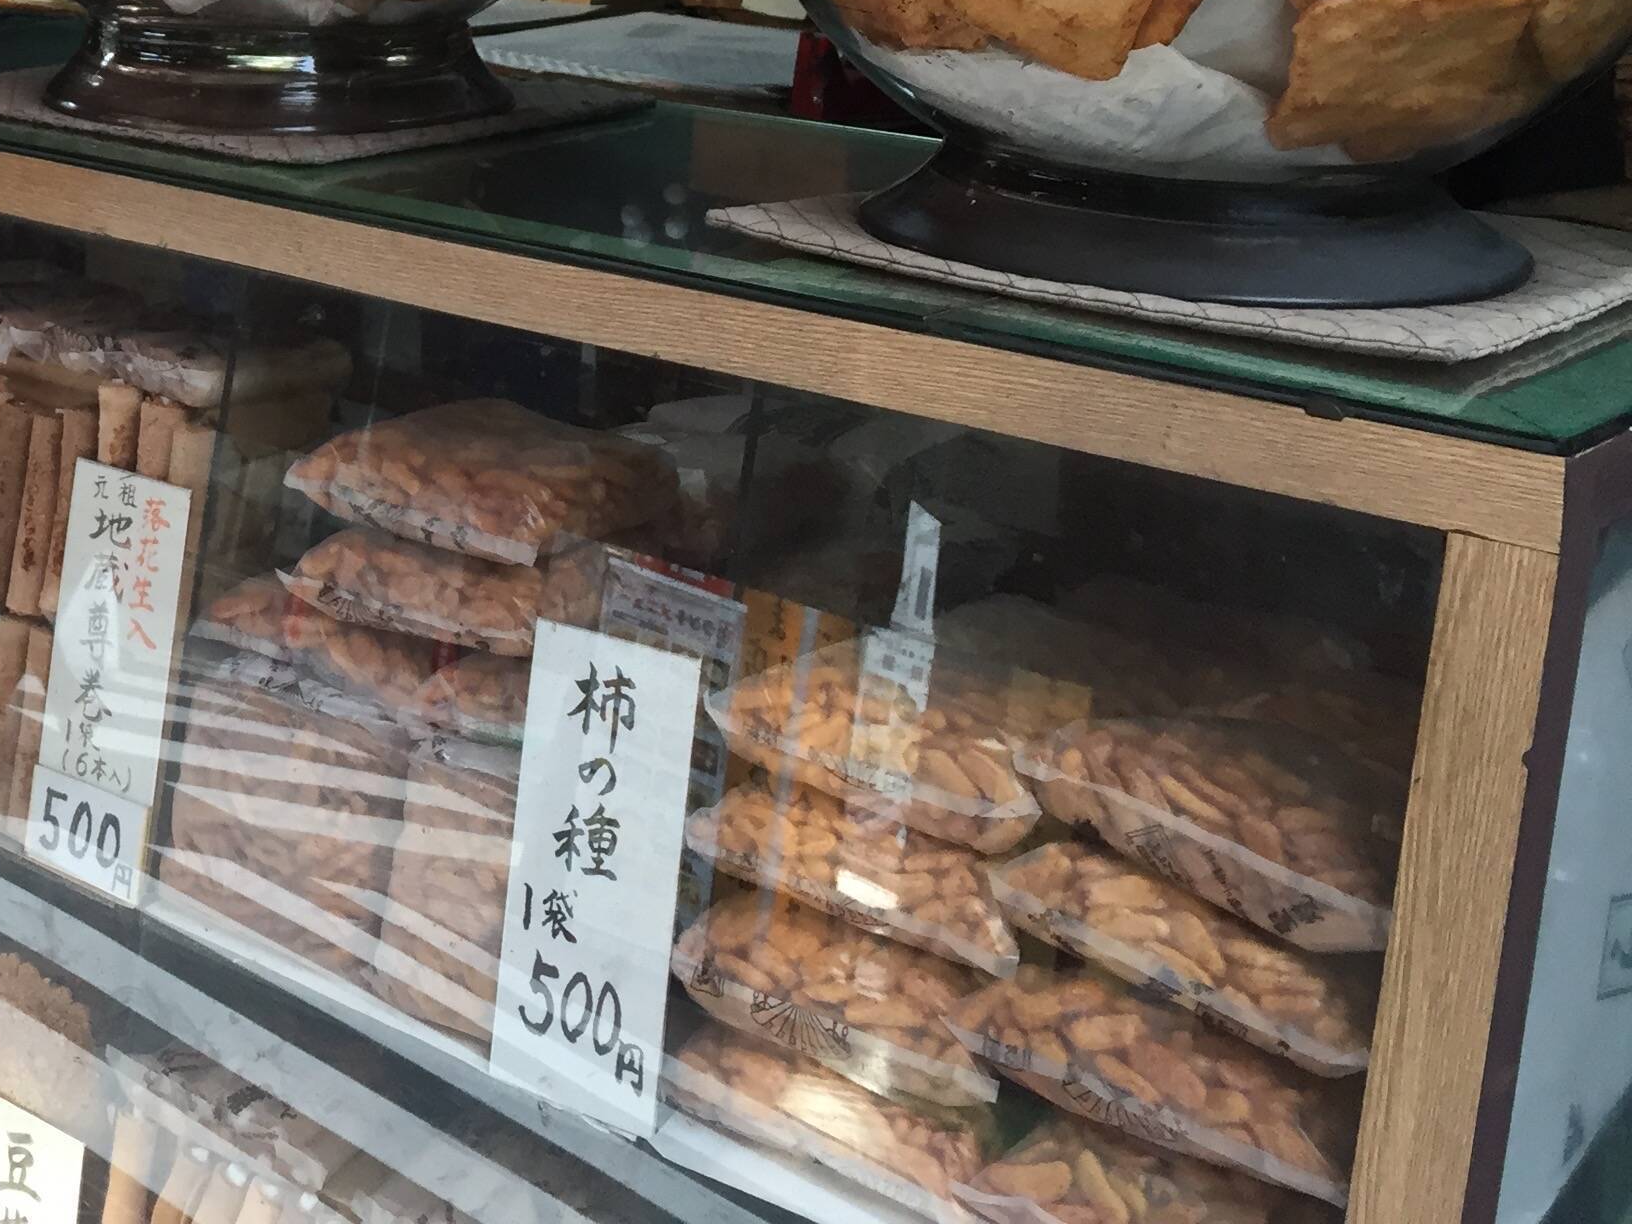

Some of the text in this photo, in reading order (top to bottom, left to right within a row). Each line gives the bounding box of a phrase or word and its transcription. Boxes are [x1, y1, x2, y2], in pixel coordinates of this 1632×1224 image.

[126, 497, 170, 651] 落花生入
[39, 786, 133, 901] 500円
[552, 661, 636, 882] 柿の種
[522, 882, 578, 946] 1袋
[518, 949, 645, 1098] 500円
